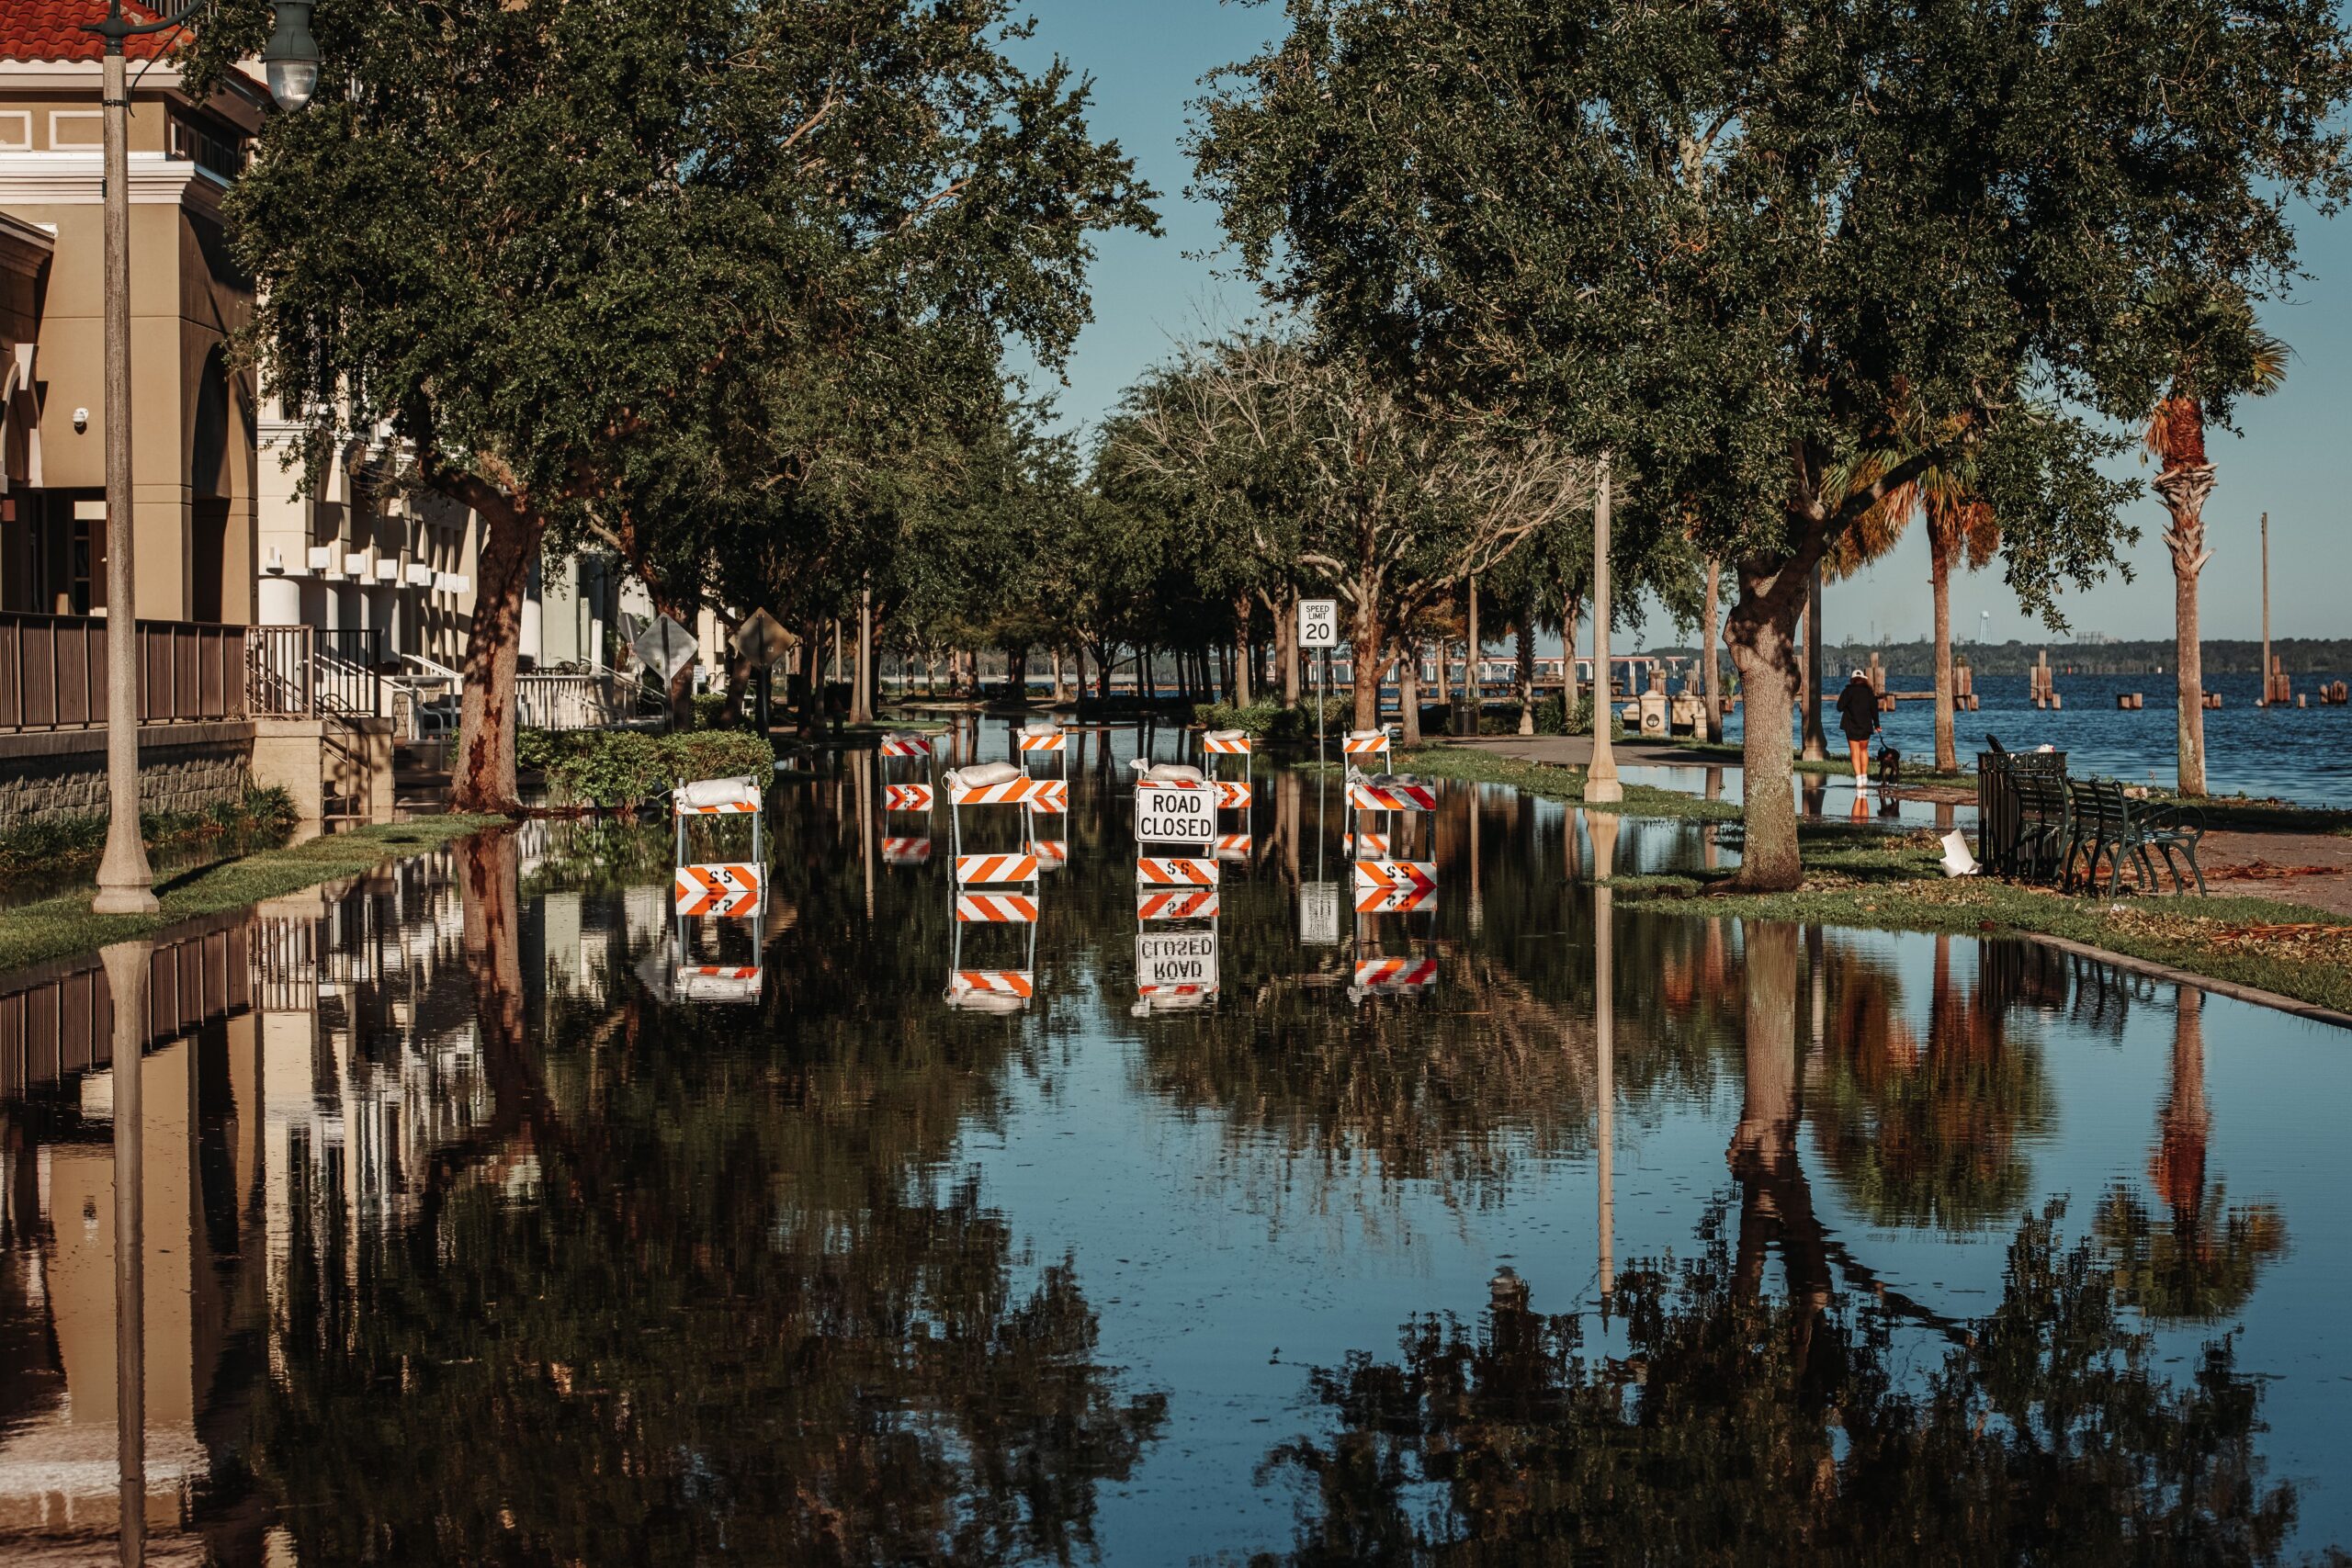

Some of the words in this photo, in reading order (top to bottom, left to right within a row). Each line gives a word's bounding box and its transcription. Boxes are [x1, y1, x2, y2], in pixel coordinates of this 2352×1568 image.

[1306, 623, 1329, 639] 20
[1153, 795, 1201, 813] ROAD
[1140, 817, 1212, 837] CLOSED
